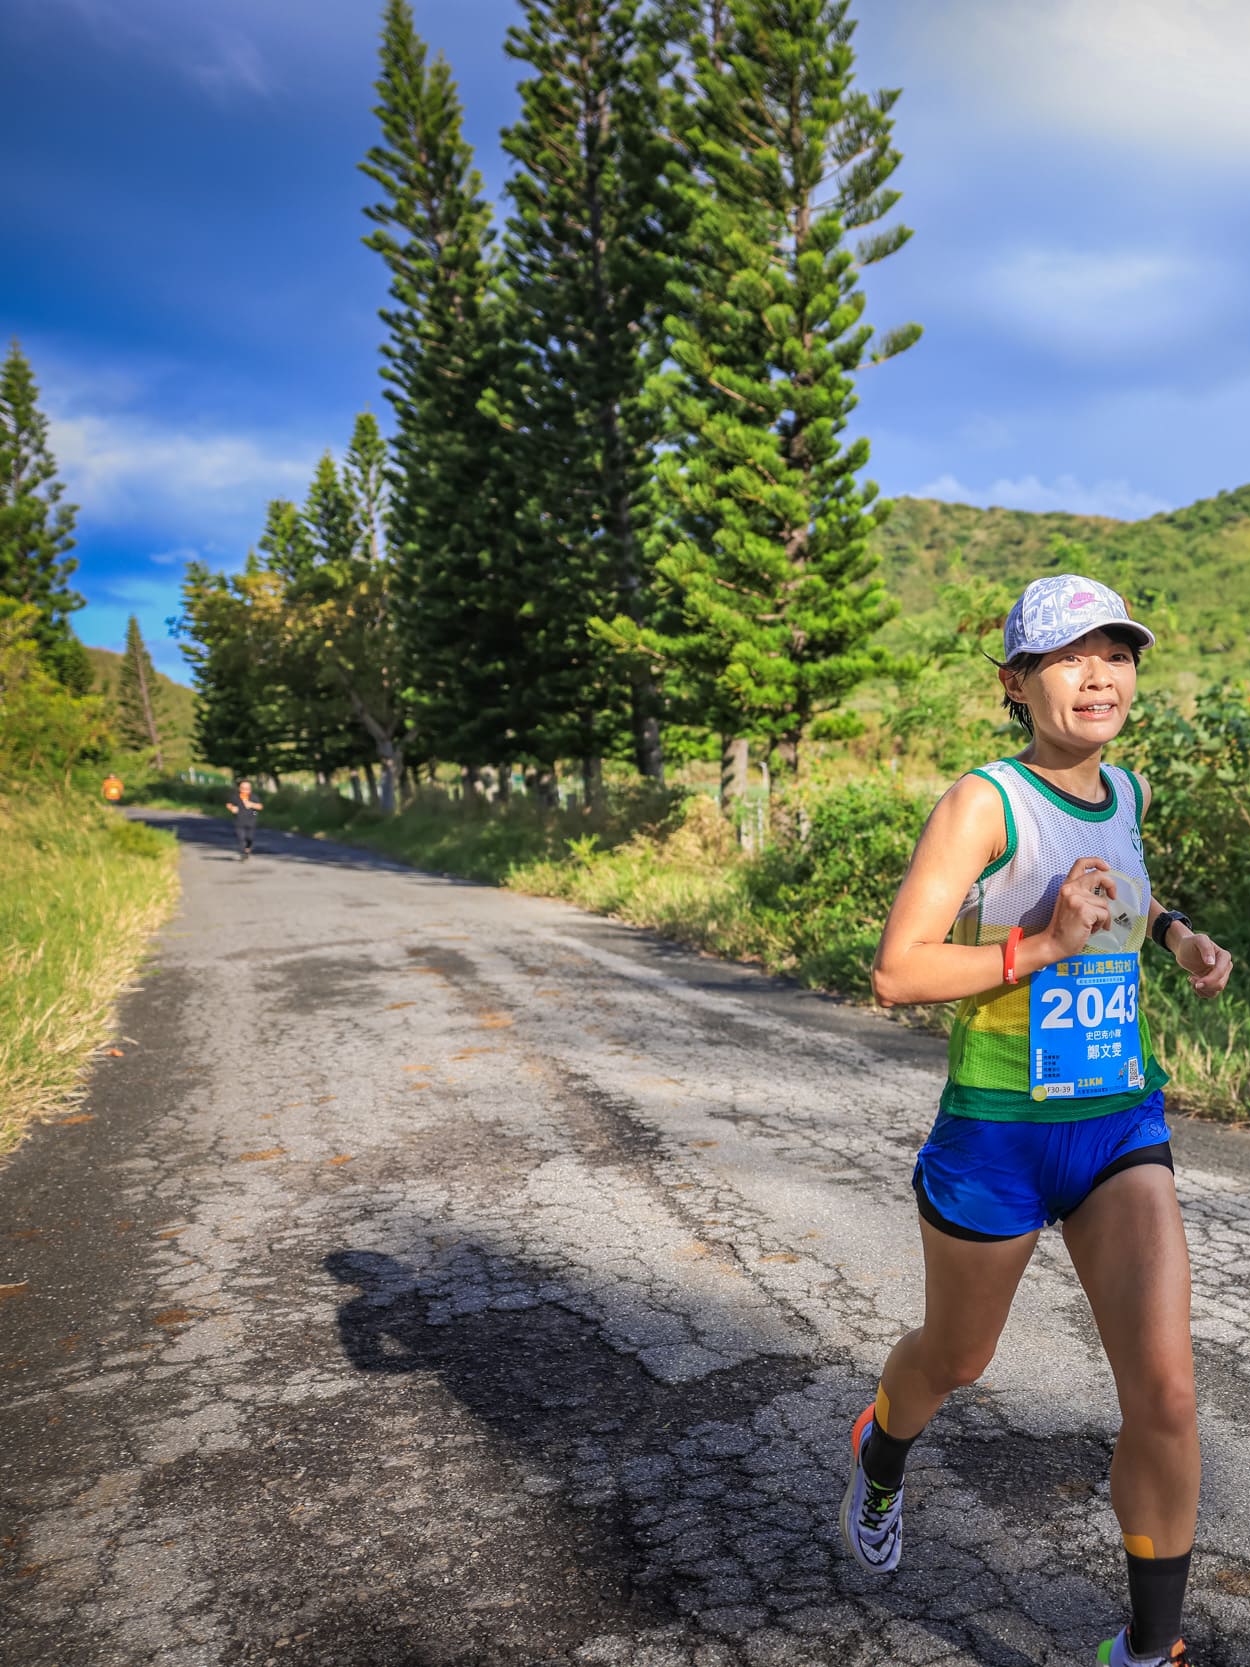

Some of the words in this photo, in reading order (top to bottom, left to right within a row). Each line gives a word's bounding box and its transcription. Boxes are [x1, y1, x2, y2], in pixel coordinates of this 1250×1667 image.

[1040, 983, 1136, 1029] 2043
[1077, 1076, 1103, 1088] 21KM
[1047, 1086, 1071, 1094] F30-39
